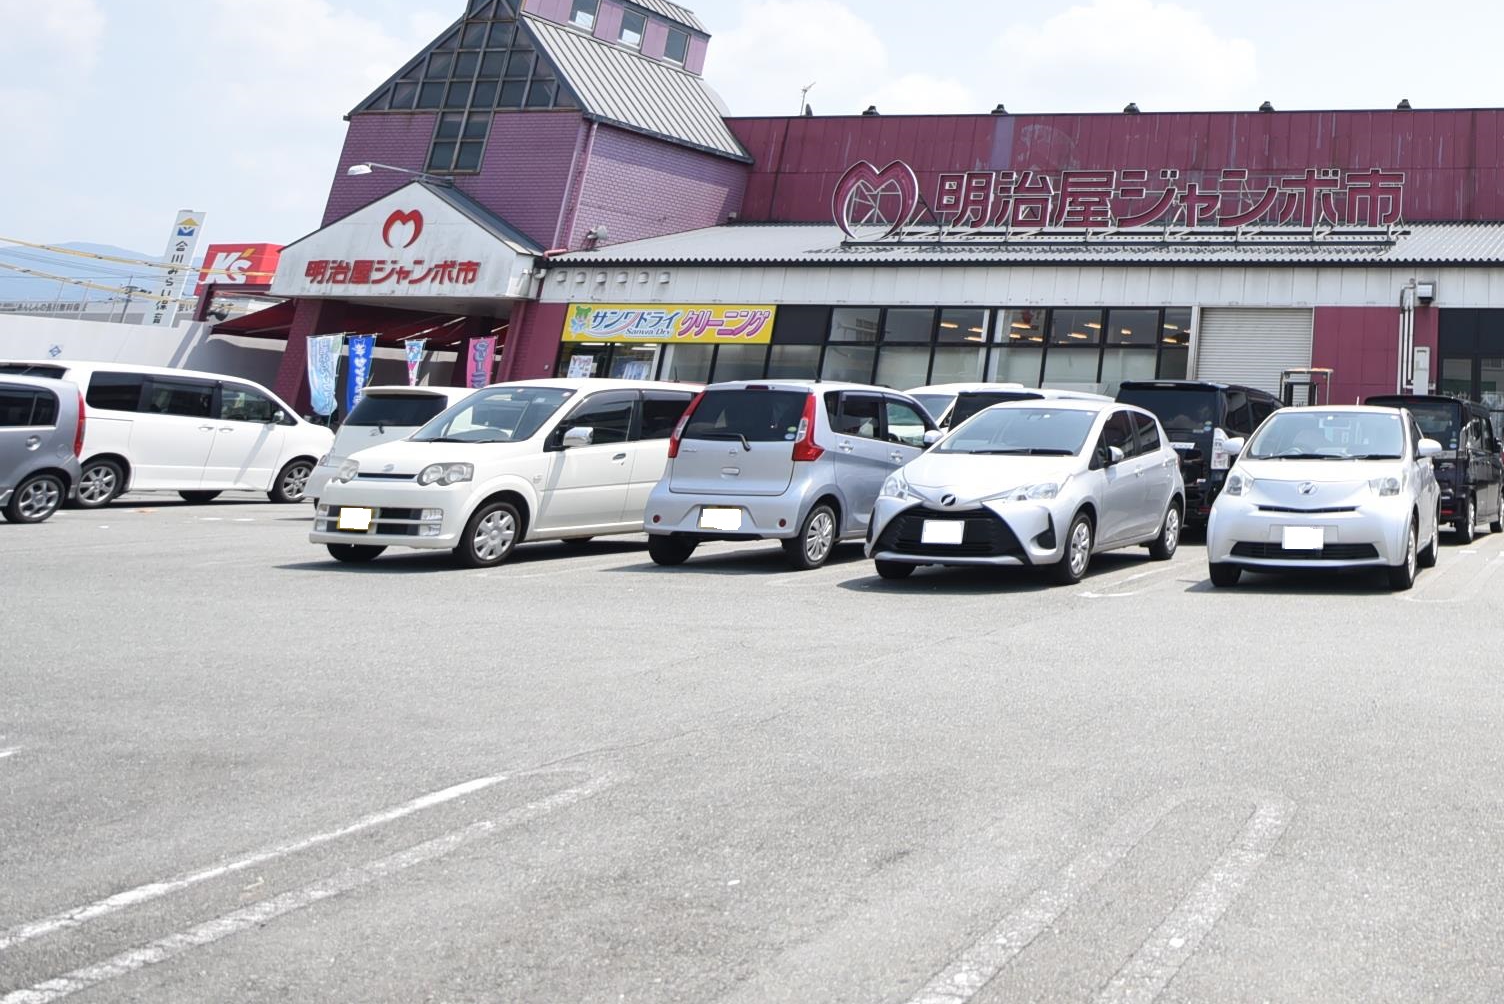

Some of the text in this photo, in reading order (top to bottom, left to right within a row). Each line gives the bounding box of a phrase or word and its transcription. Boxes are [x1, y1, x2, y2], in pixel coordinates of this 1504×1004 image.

[934, 168, 1405, 229] 明治屋ジャンボ市
[304, 260, 482, 286] 明治屋ジャンボ市
[592, 309, 771, 337] サンワドライ クリーニング
